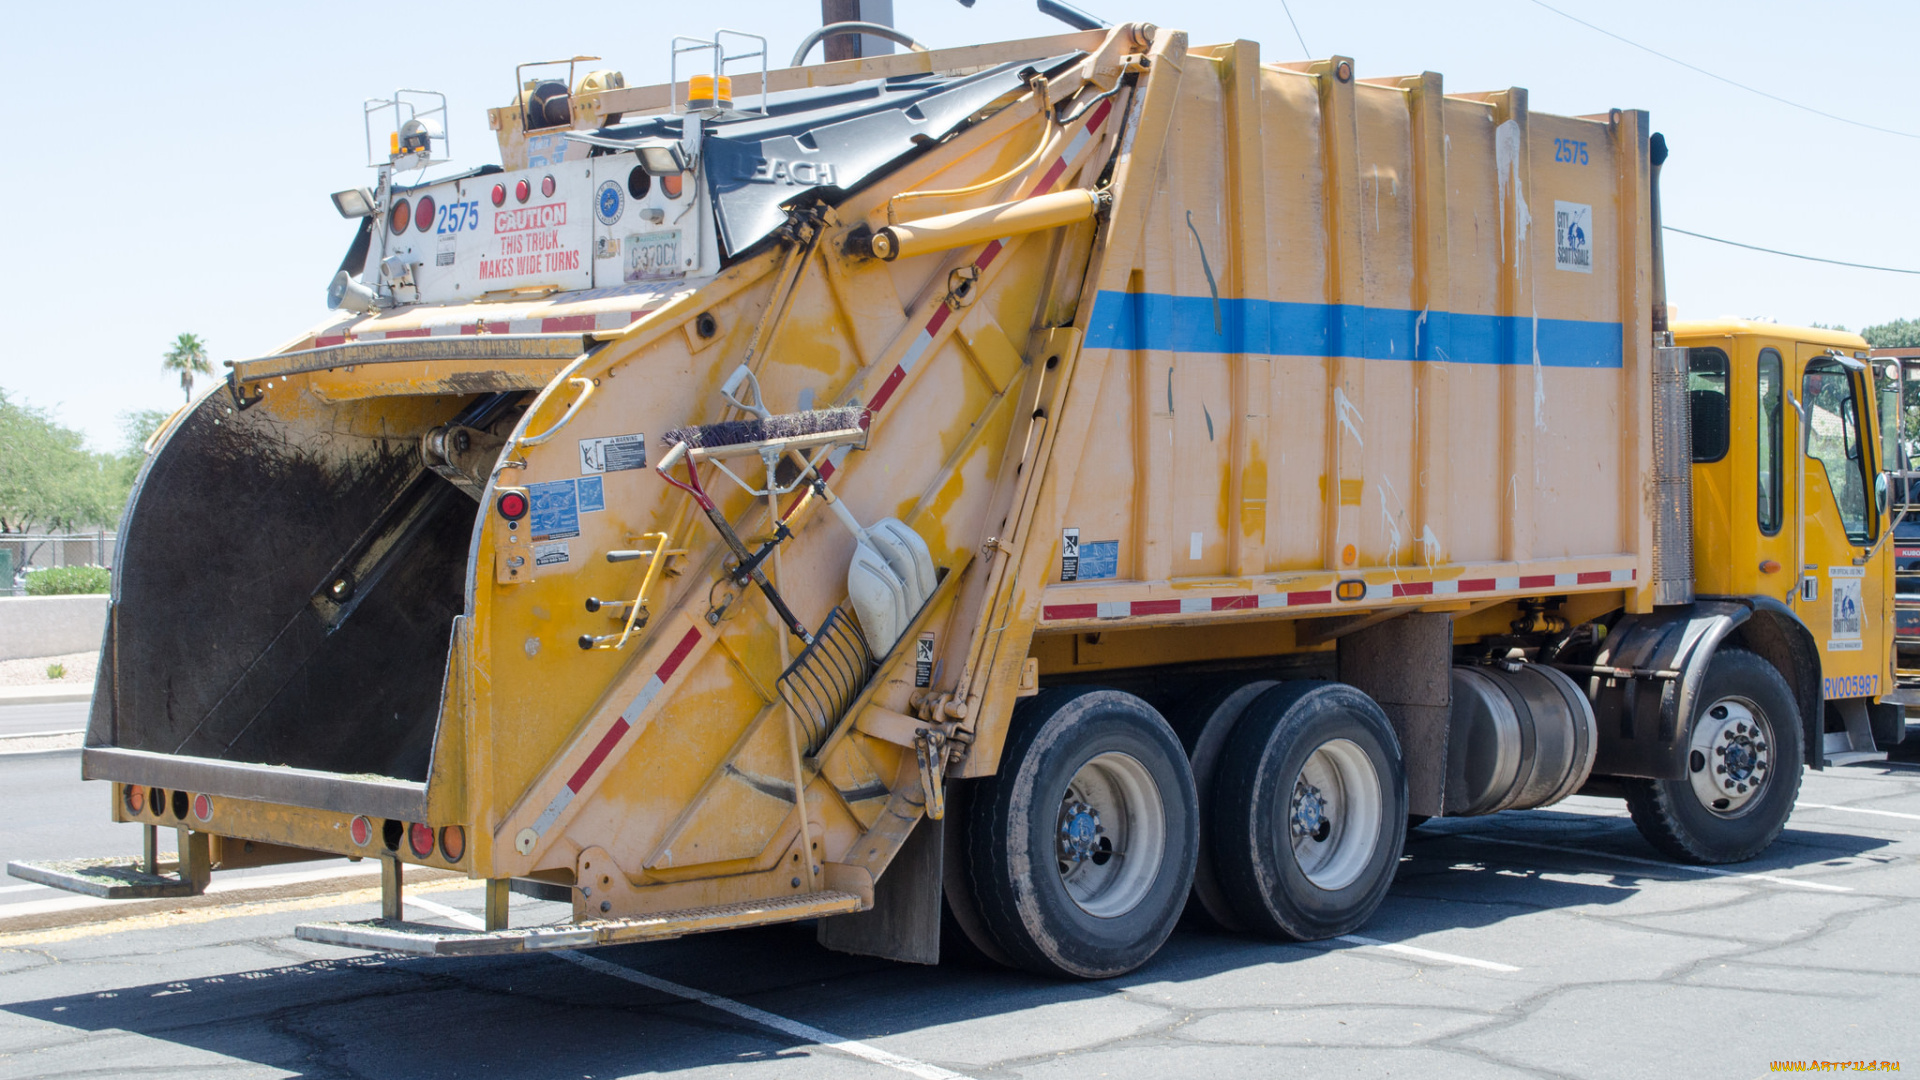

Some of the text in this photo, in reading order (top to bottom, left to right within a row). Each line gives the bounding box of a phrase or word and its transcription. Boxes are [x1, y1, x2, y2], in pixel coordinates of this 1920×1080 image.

[1554, 138, 1589, 165] 2575
[437, 201, 479, 234] 2575
[495, 203, 566, 232] CAUTION
[1557, 211, 1569, 229] CITY
[501, 229, 559, 255] THIS TRUCK
[1557, 229, 1564, 246] OF
[479, 250, 579, 280] MAKES WIDE TURNS
[1557, 246, 1589, 266] SCOTTSDALE
[1824, 675, 1878, 698] RV005987
